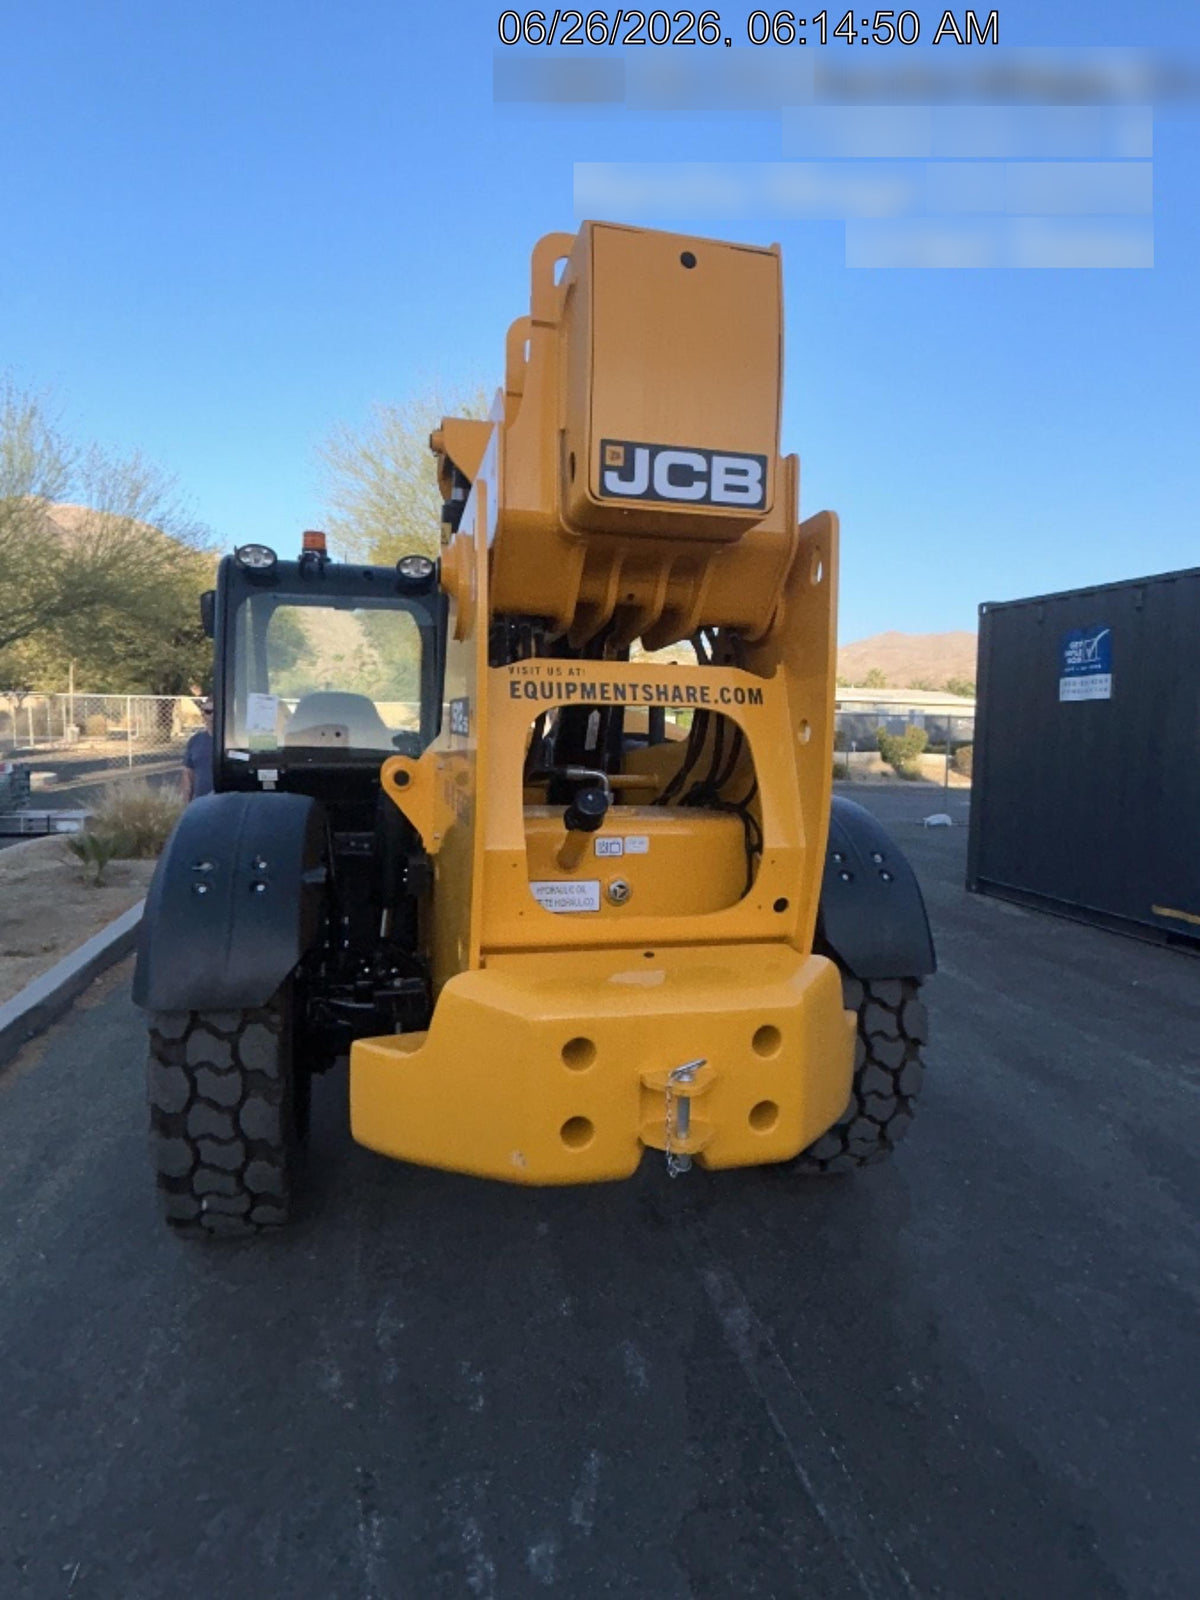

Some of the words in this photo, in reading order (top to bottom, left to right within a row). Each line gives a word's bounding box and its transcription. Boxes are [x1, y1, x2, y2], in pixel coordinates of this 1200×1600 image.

[604, 447, 763, 504] JCB
[508, 666, 540, 676] VISIT
[547, 667, 562, 676] US
[509, 680, 764, 705] EQUIPMENTSHARE.COM
